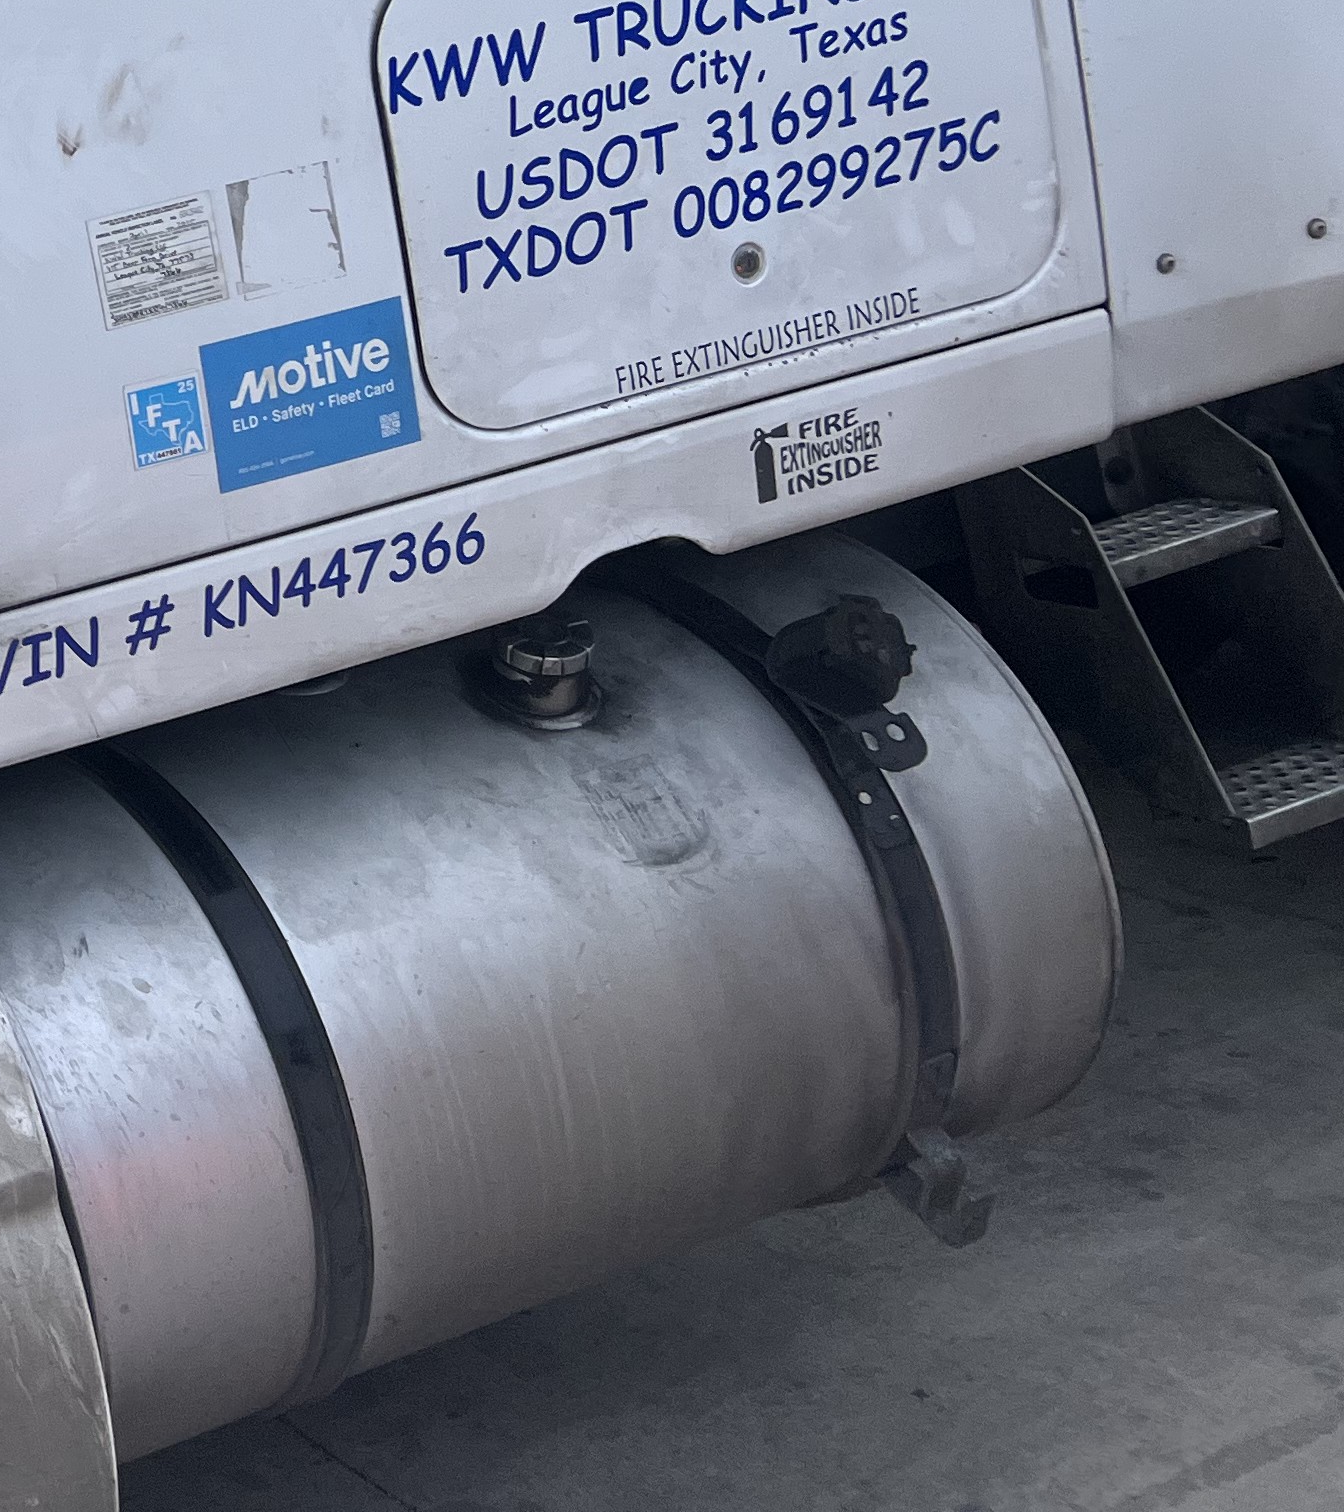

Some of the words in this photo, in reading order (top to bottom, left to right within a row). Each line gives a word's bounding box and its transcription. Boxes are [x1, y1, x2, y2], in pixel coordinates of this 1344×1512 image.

[386, 21, 546, 114] KWW
[509, 76, 650, 137] League
[670, 49, 767, 96] City,
[789, 12, 909, 63] Texas
[476, 122, 678, 220] USDOT
[706, 59, 931, 162] 3169142
[444, 199, 649, 293] TXDOT
[673, 110, 1002, 238] 008299275C
[230, 338, 390, 410] Motive
[615, 356, 665, 394] FIRE
[672, 309, 841, 379] EXTINGUISHER
[847, 287, 921, 331] INSIDE
[177, 380, 195, 394] 25
[232, 415, 259, 433] ELD
[272, 402, 315, 423] Safety
[328, 389, 362, 408] Fleet
[364, 379, 395, 398] Card
[799, 407, 859, 439] FIRE
[138, 452, 158, 465] TX
[780, 420, 883, 474] EXTINGUISHER
[787, 454, 880, 496] INSIDE
[125, 594, 175, 656] #
[203, 512, 486, 637] KN447366
